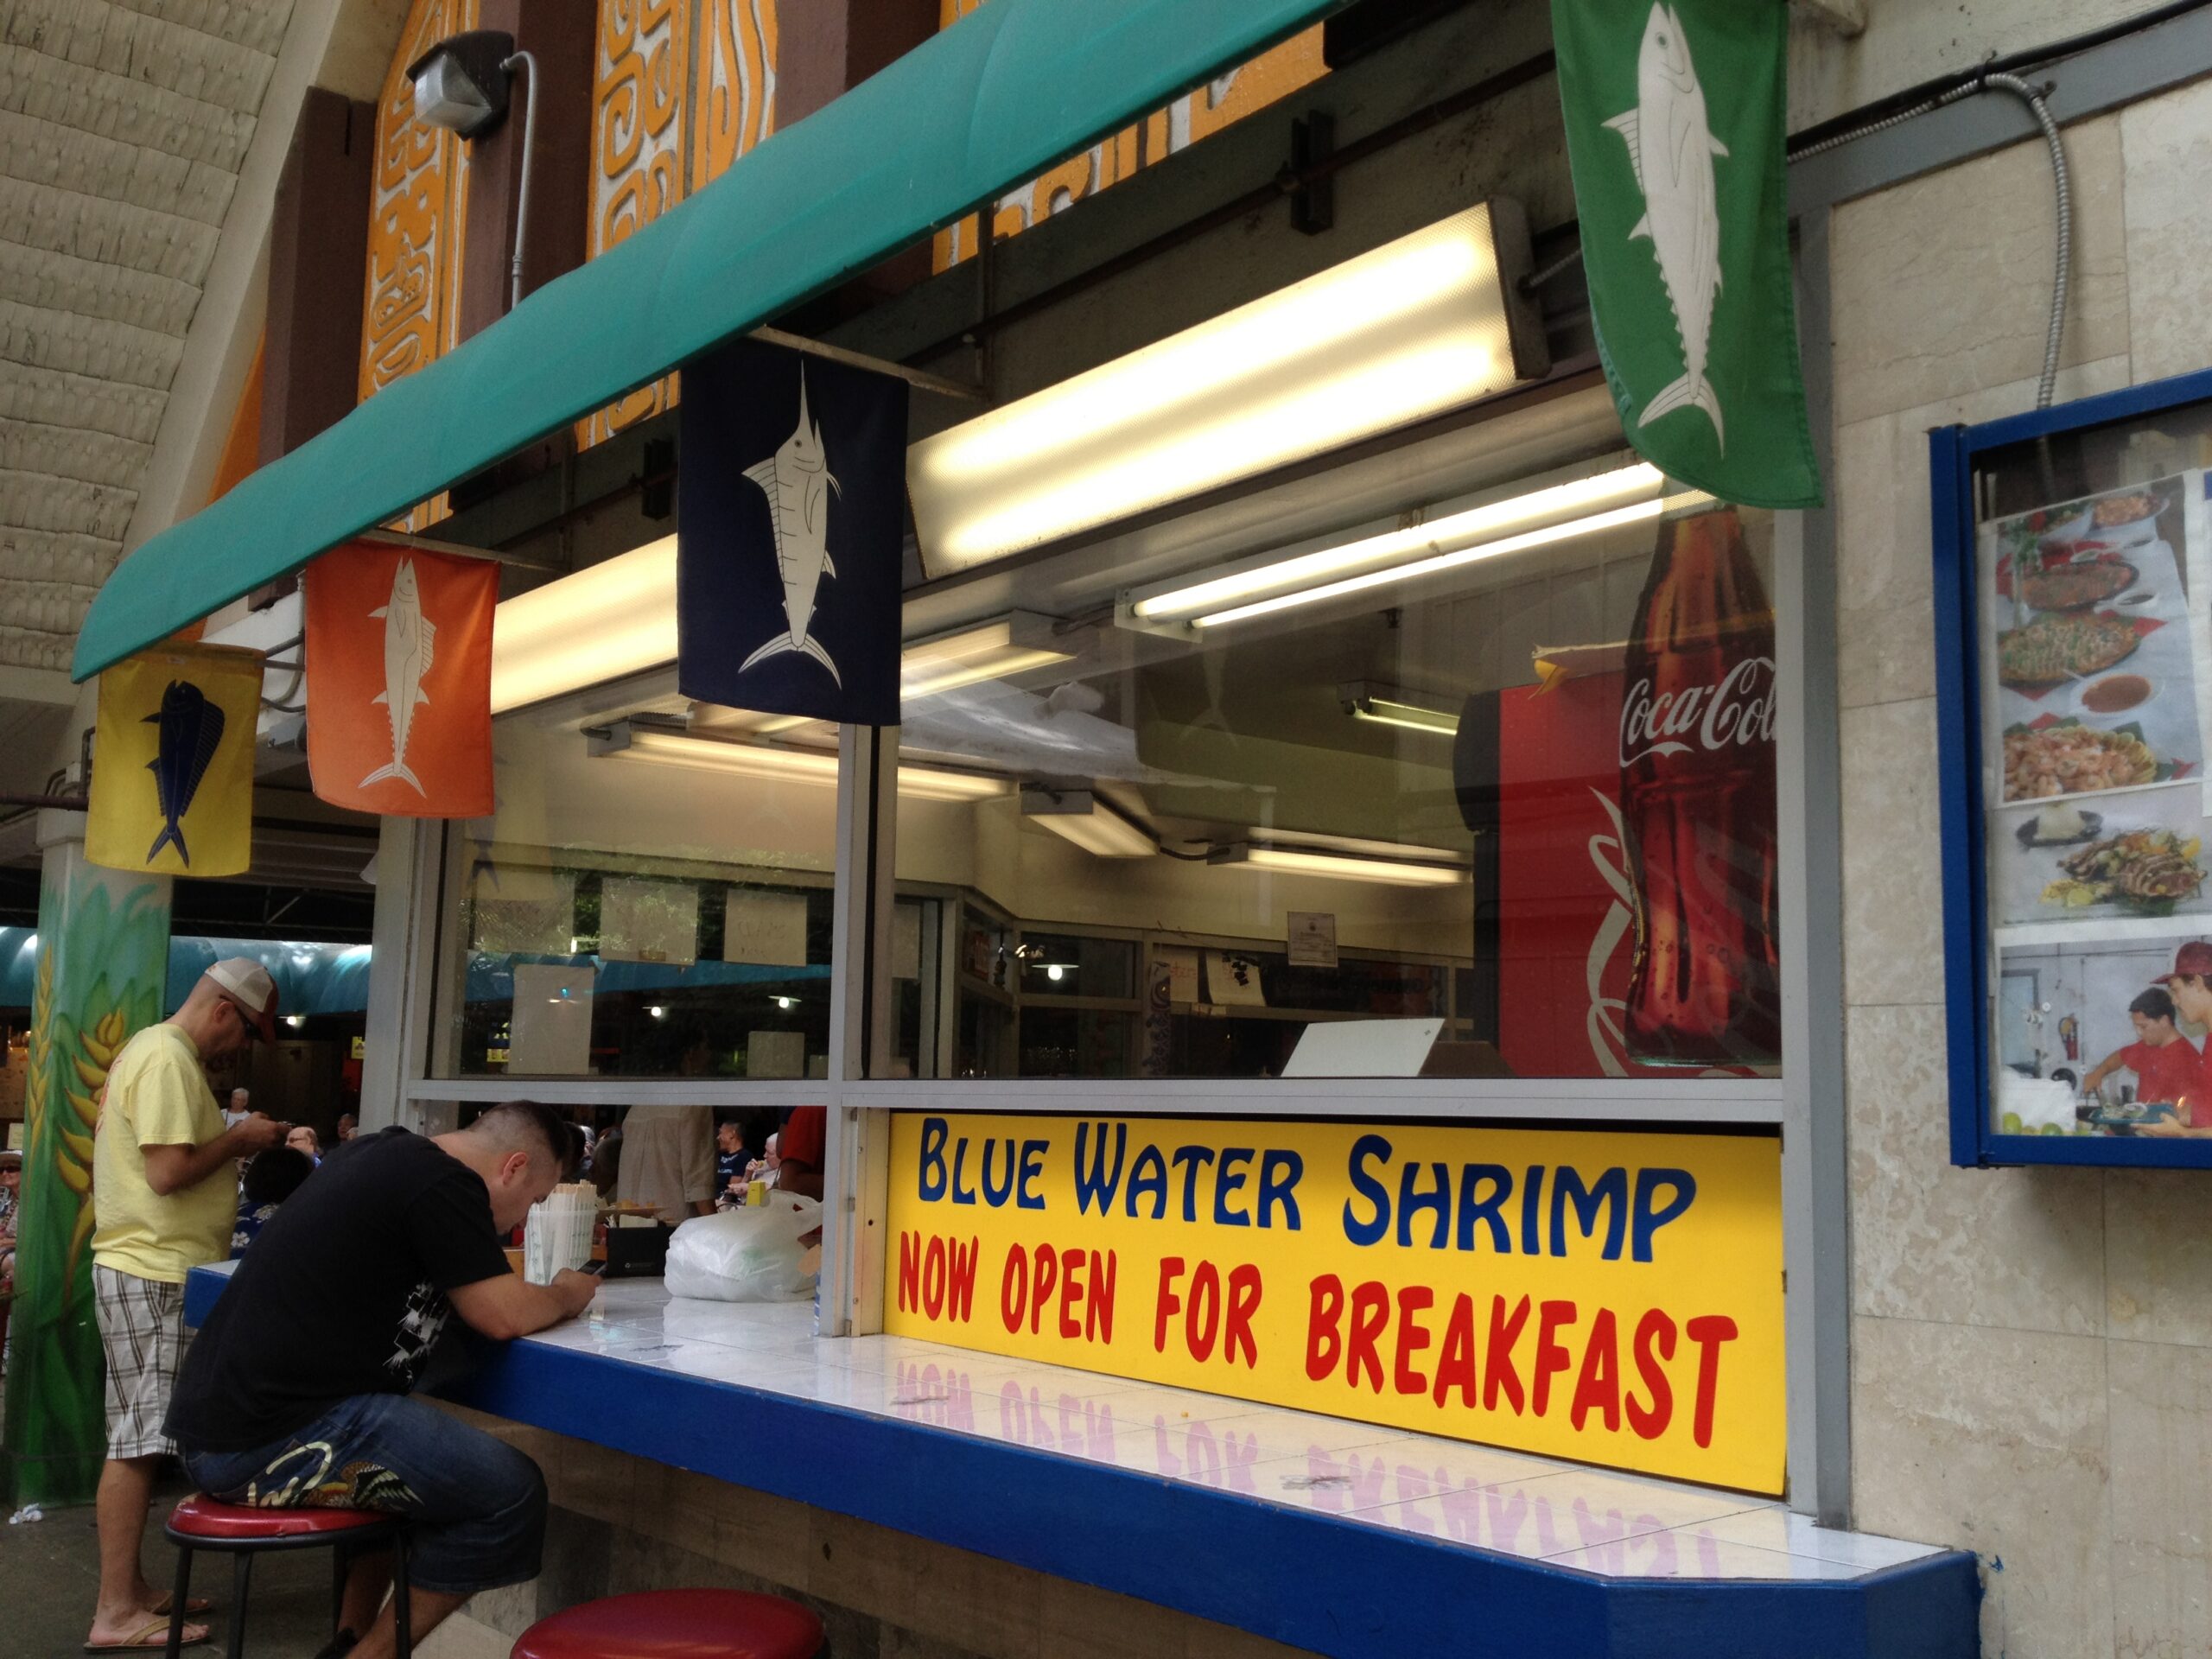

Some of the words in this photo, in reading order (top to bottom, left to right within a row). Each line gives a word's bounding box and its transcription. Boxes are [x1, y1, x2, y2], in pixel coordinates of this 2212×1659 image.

[1619, 657, 1777, 768] Coca-Col
[918, 1117, 1050, 1210] BLUE
[1074, 1122, 1302, 1231] WATER
[1342, 1134, 1698, 1263] SHRIMP
[898, 1230, 979, 1323] NOW
[1001, 1243, 1117, 1344] OPEN
[1154, 1256, 1263, 1370] FOR
[1306, 1273, 1739, 1449] BREAKFAST
